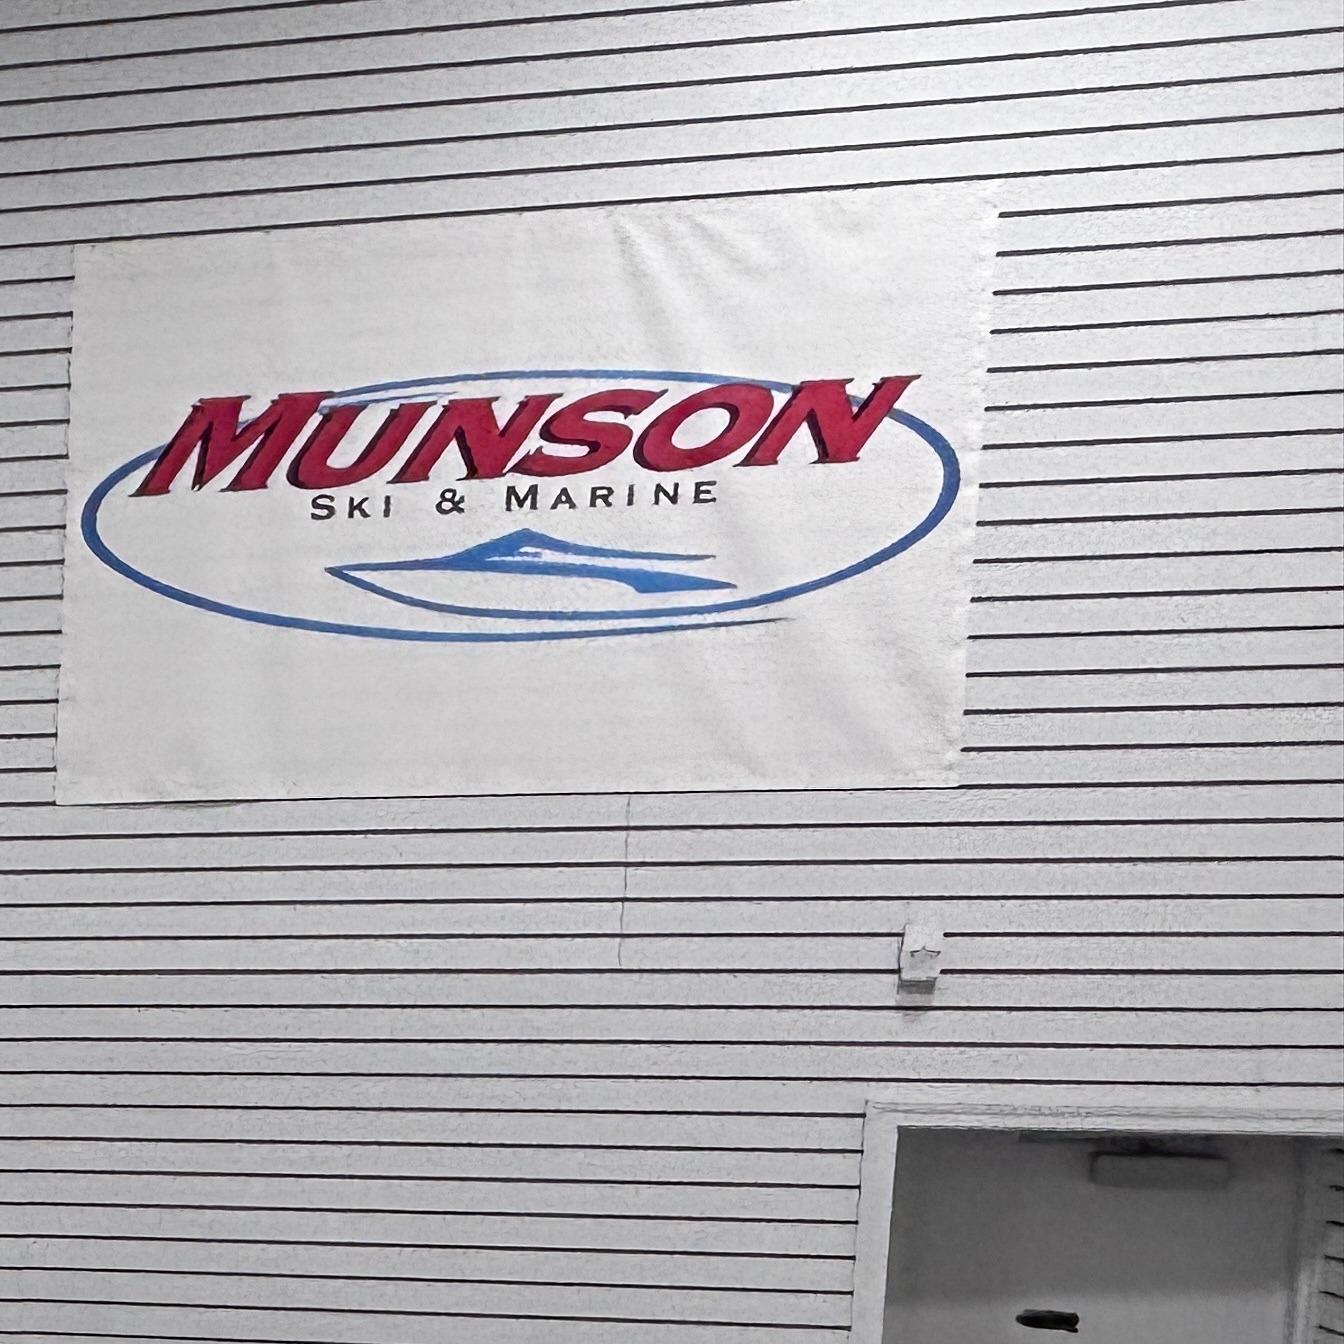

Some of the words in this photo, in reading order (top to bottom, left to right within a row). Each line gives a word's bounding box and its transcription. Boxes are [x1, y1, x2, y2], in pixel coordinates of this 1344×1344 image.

[129, 374, 923, 497] MUNSON
[311, 490, 391, 521] SKI
[435, 487, 466, 515] &
[505, 482, 718, 513] MARINE
